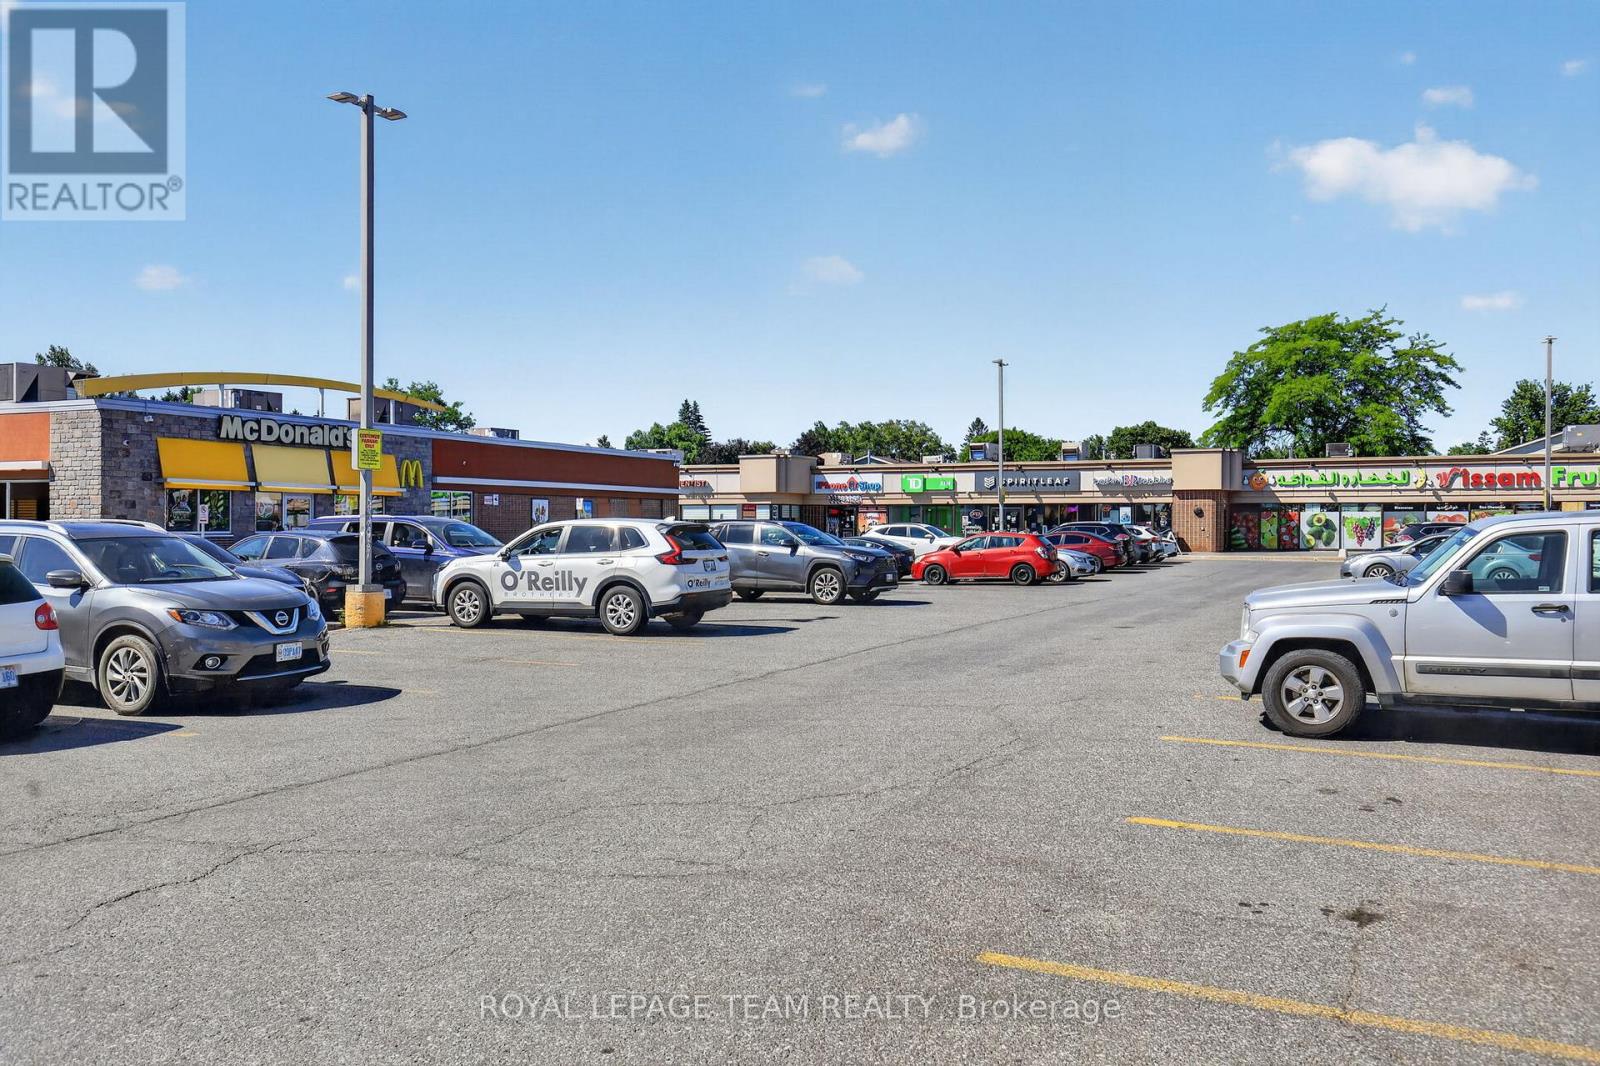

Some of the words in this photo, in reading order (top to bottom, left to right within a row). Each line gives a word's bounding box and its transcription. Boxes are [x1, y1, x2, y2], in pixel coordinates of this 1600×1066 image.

[219, 415, 352, 448] McDonald's
[908, 478, 922, 489] TD
[1436, 466, 1542, 489] Wissam
[1551, 466, 1600, 487] Fru
[501, 570, 588, 598] O'Reilly
